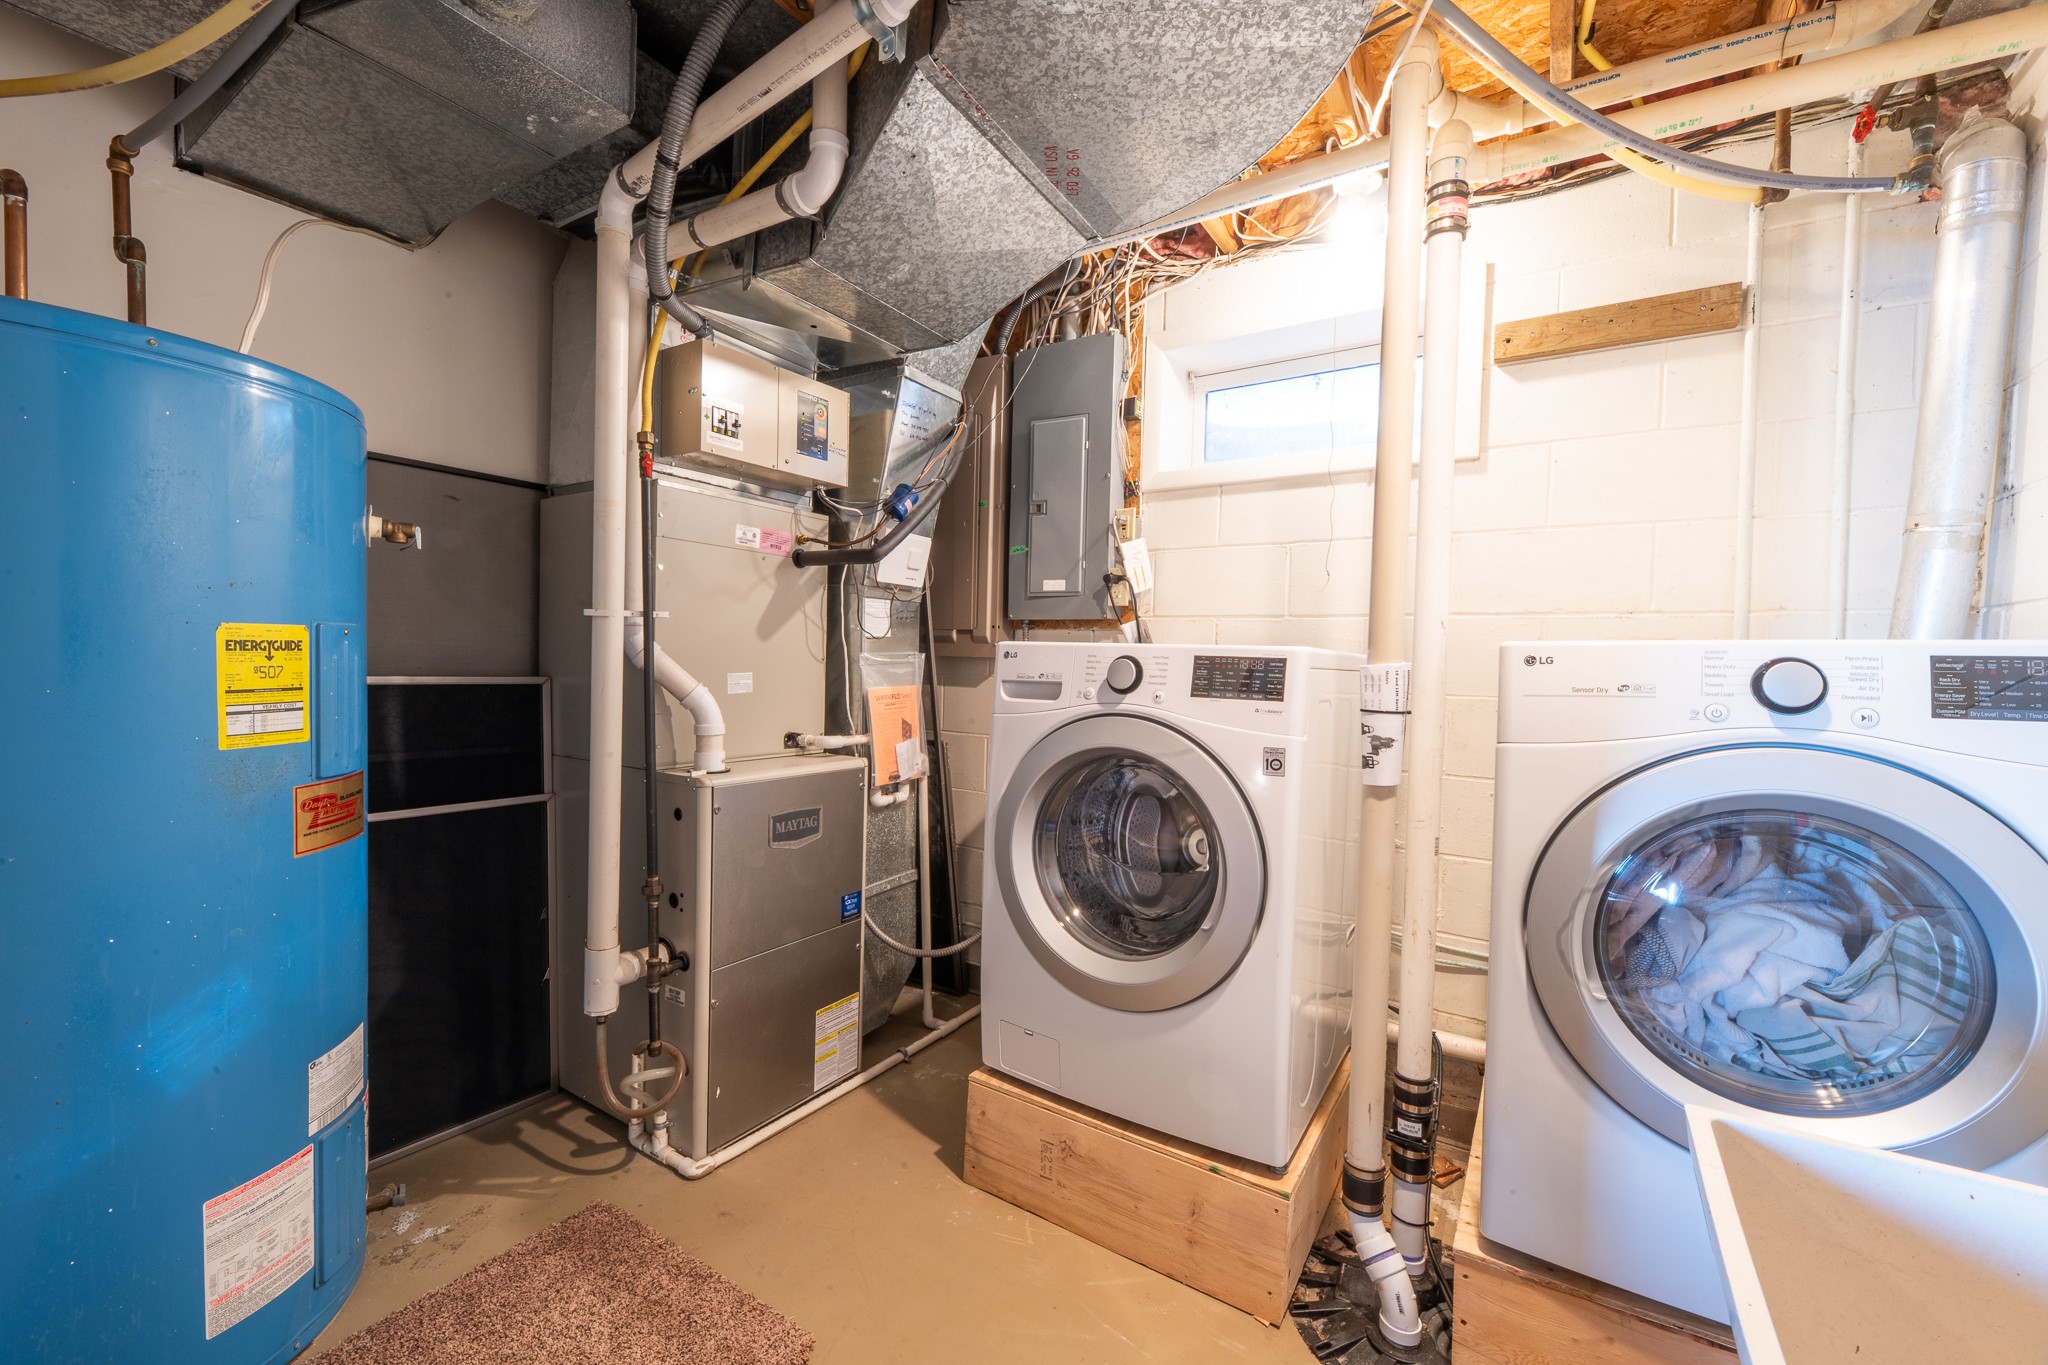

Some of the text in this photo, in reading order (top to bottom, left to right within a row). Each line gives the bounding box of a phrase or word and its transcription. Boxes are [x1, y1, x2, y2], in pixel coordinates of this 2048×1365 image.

[1044, 145, 1058, 162] USA
[1066, 148, 1079, 160] GA
[1067, 167, 1080, 177] 26
[225, 640, 302, 652] ENERGYGUIDE
[1539, 656, 1554, 665] LG
[254, 666, 284, 679] $507
[875, 693, 900, 702] WARMFLO
[1266, 758, 1282, 771] 10
[304, 798, 336, 811] Dayton
[776, 816, 817, 834] MAYTAG
